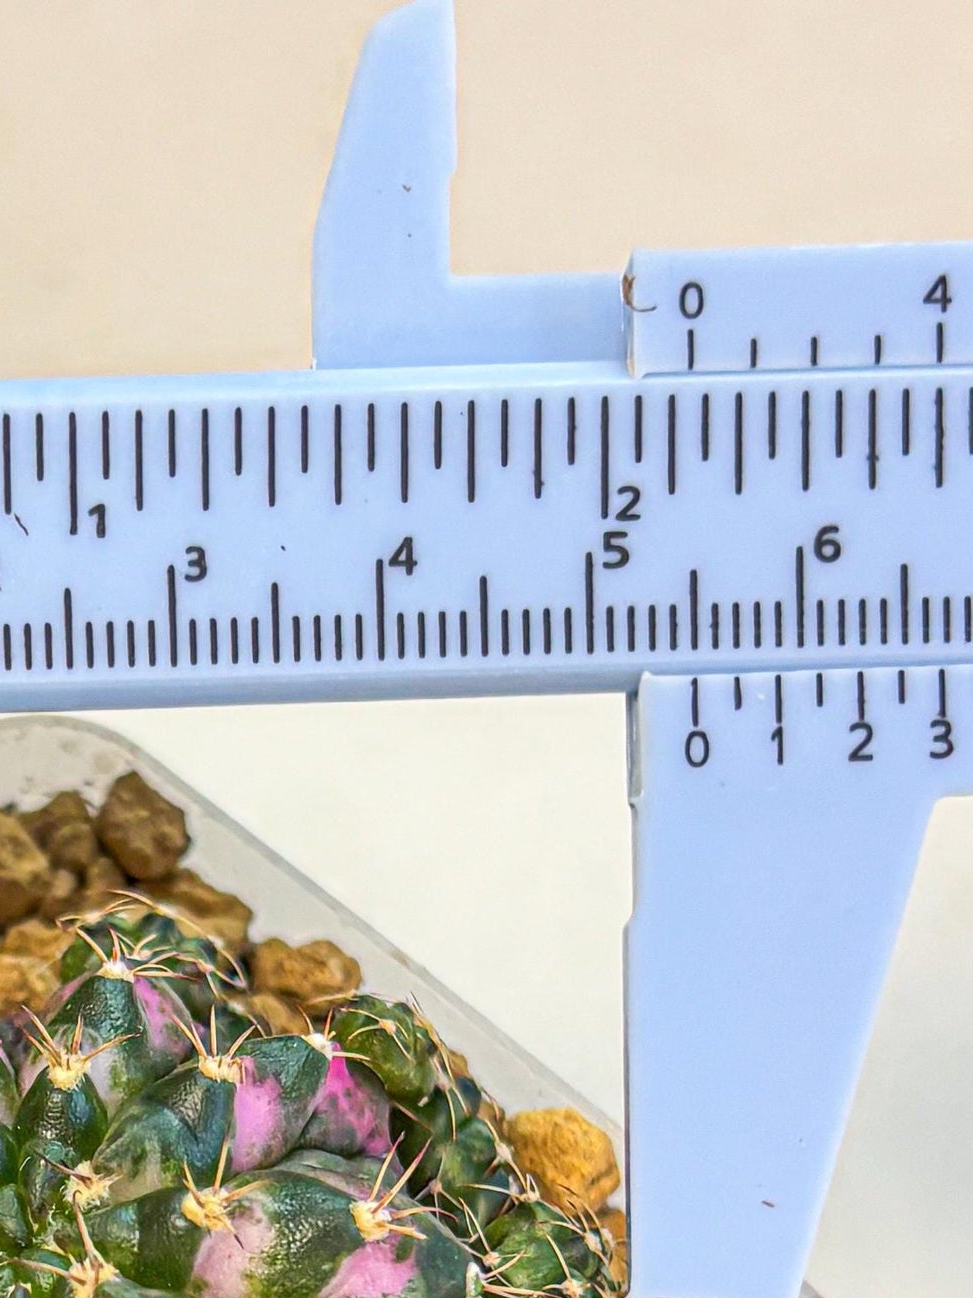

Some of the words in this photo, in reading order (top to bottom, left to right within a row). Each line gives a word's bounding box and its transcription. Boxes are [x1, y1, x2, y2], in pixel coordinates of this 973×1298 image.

[679, 281, 705, 320] 0
[922, 274, 953, 313] 4
[87, 503, 107, 539] 1
[615, 486, 641, 521] 2
[184, 545, 209, 583] 3
[388, 537, 418, 576] 4
[601, 531, 630, 569] 5
[813, 525, 842, 563] 6
[685, 730, 710, 768] 0
[770, 726, 785, 766] 1
[848, 722, 874, 763] 2
[930, 719, 955, 760] 3
